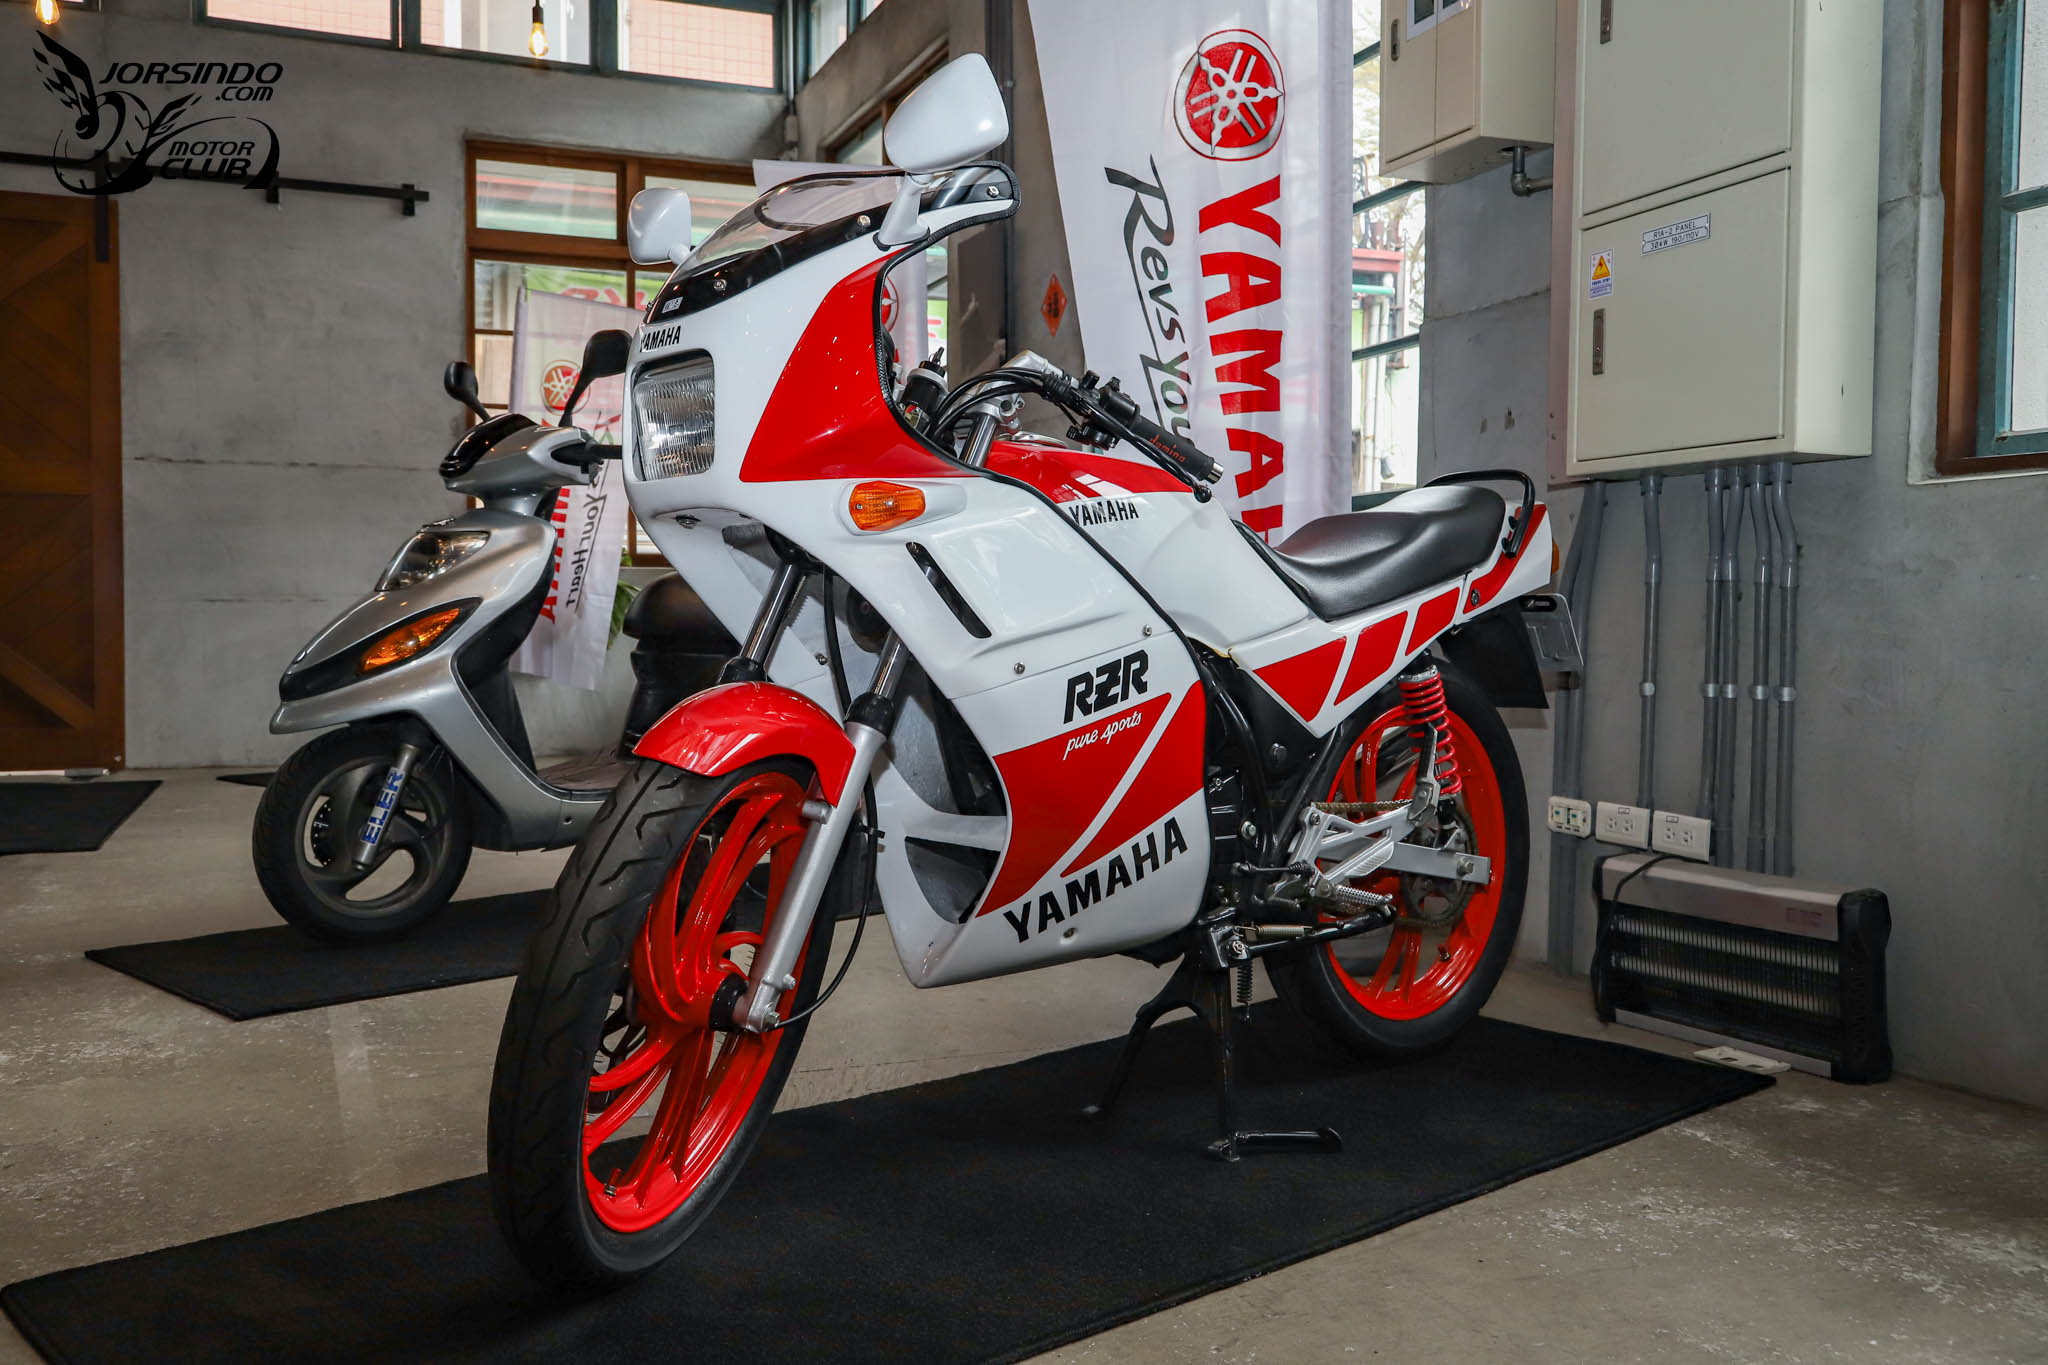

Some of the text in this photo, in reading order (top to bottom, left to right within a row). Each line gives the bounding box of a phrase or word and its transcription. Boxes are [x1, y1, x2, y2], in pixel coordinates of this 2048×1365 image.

[1675, 220, 1697, 233] PANEL
[1104, 153, 1193, 441] Revs You
[640, 325, 681, 352] YAMAHA
[1199, 174, 1283, 547] YAMA
[1068, 500, 1139, 527] YAMAHA
[1063, 649, 1149, 724] RZR
[1063, 711, 1142, 760] pure sports
[1003, 816, 1188, 943] YAMAHA
